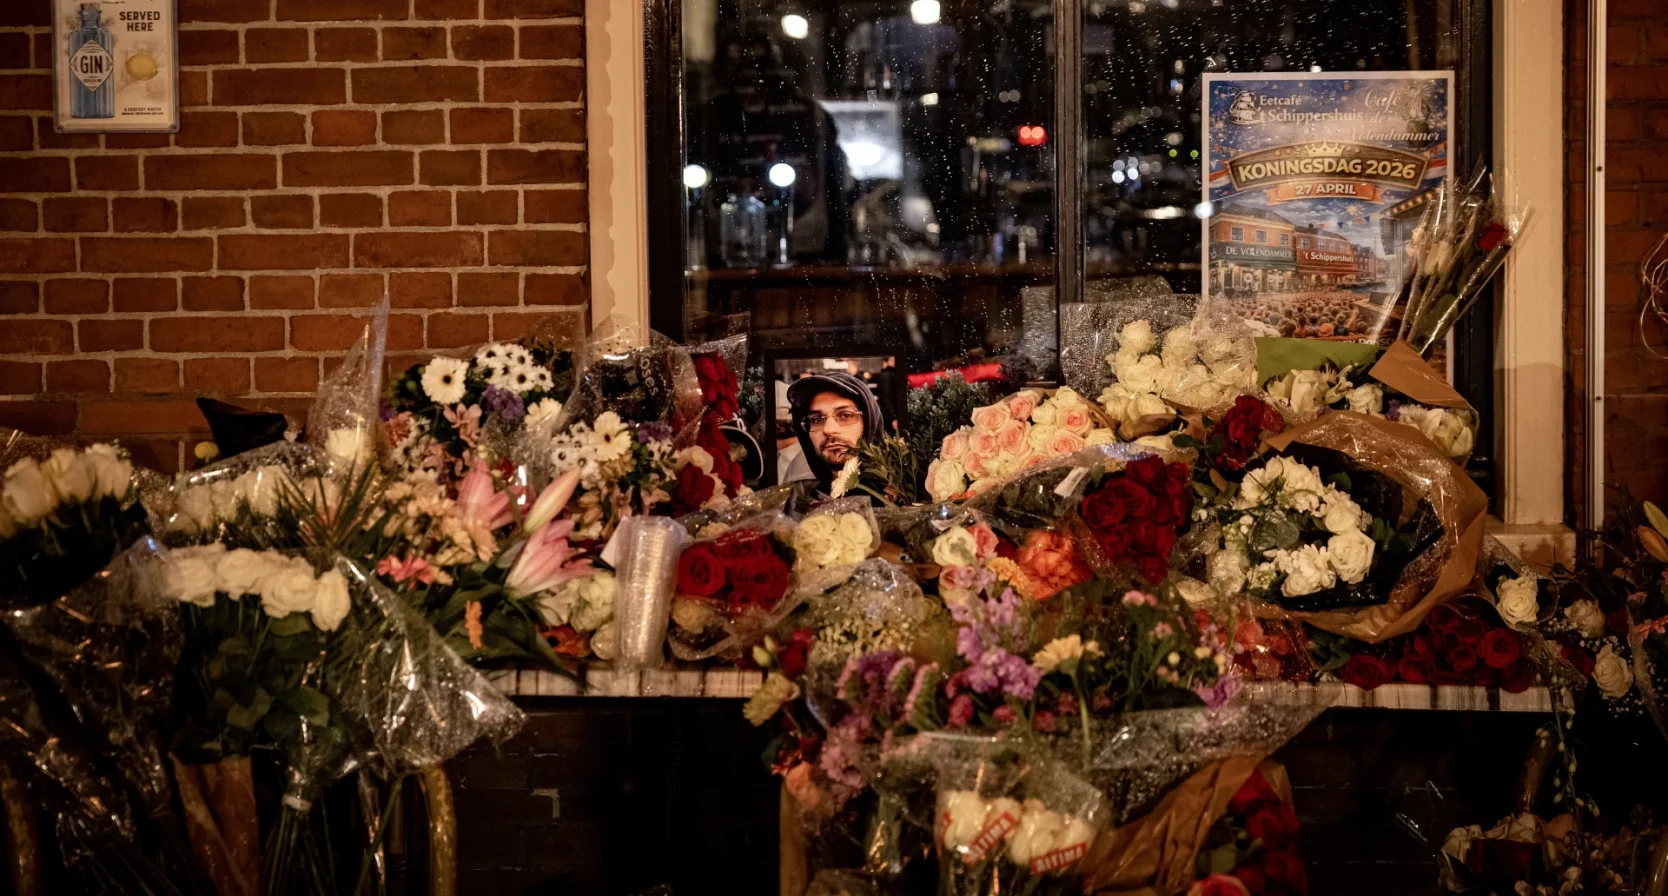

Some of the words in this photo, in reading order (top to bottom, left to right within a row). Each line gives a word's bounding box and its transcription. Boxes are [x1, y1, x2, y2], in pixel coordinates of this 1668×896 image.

[119, 11, 161, 21] SERVED
[127, 22, 154, 32] HERE
[80, 55, 103, 74] GIN
[1259, 94, 1302, 106] Eetcafé
[1268, 108, 1364, 125] Schippershuis
[1350, 124, 1440, 141] Volendammer
[1237, 158, 1362, 182] KONINGSDAG
[1366, 159, 1416, 179] 2026
[1295, 184, 1312, 195] 27
[1315, 183, 1357, 195] APRIL
[1225, 246, 1238, 255] DE
[1240, 247, 1293, 259] VOLENDAMMER
[1310, 251, 1354, 263] Schippershuis
